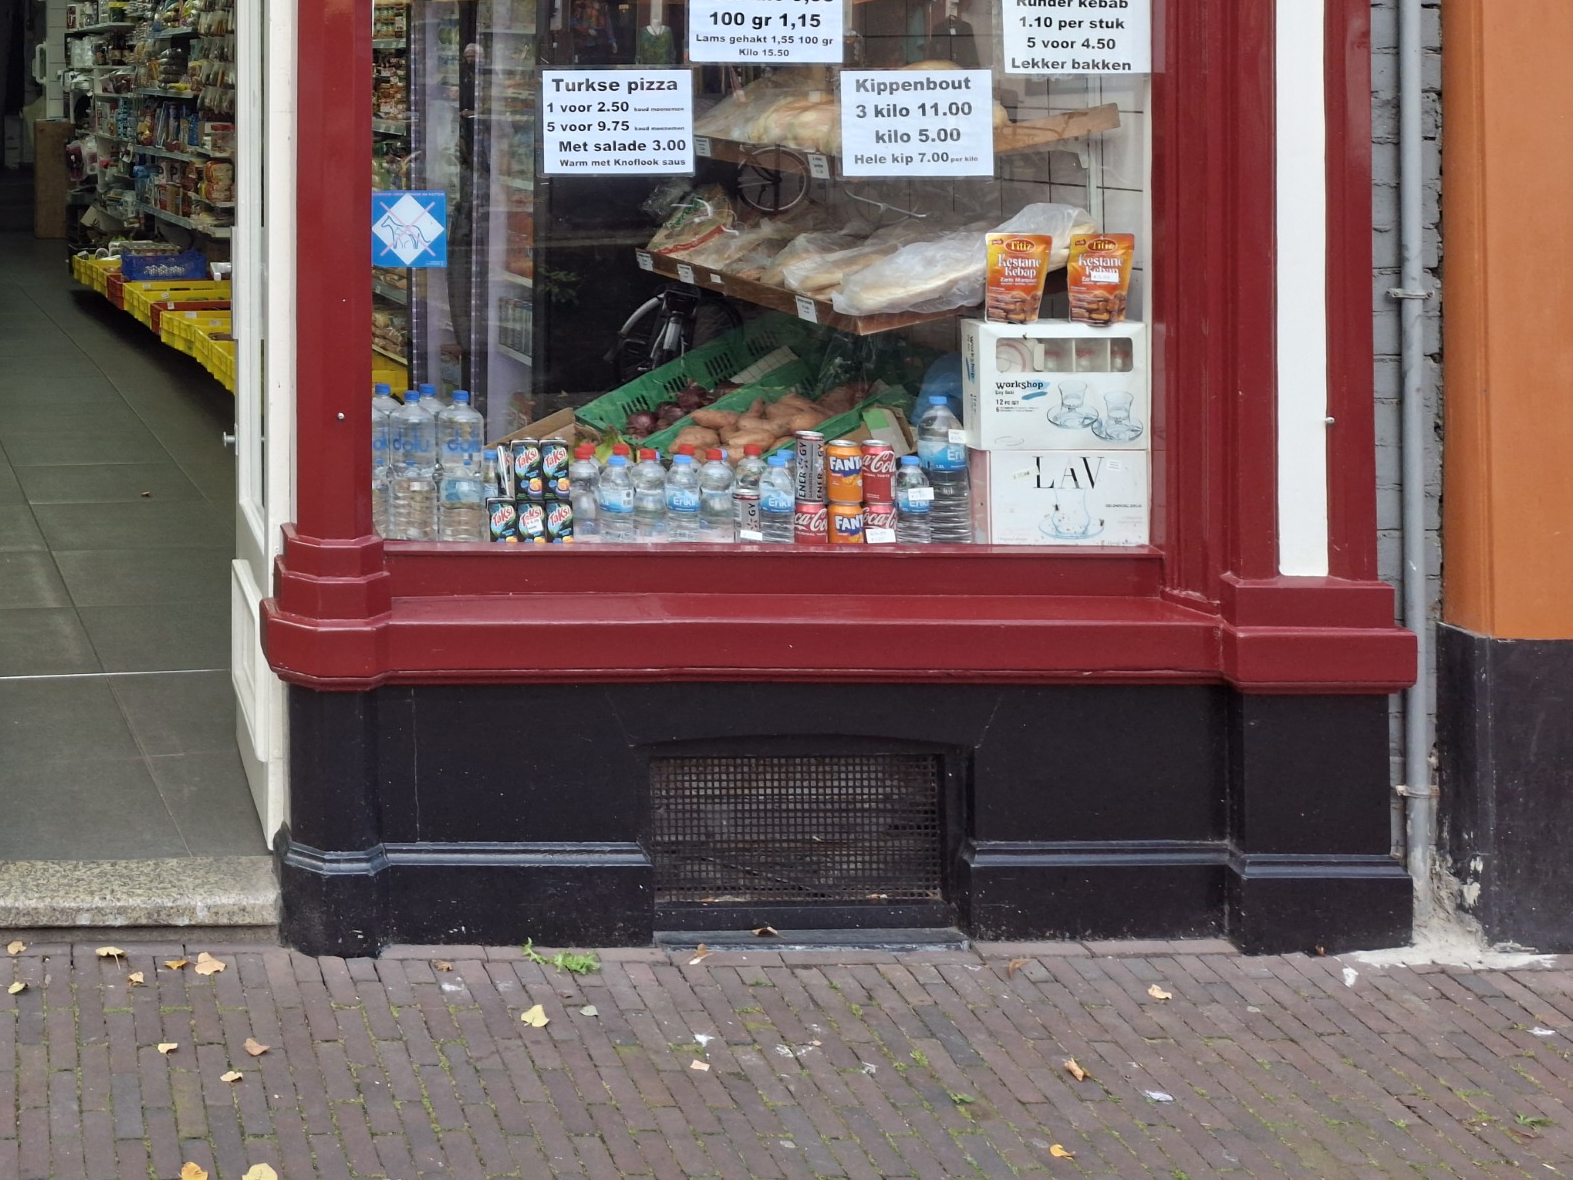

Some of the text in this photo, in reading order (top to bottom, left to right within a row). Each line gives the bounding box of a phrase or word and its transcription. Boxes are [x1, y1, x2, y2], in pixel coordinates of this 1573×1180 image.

[709, 12, 822, 30] 100 gr 1,15
[1019, 16, 1126, 32] 1.10 per stuk
[696, 34, 834, 47] Lams gehakt 1,55 100 gr
[1026, 36, 1116, 51] 5 voor 4.50
[738, 49, 790, 57] Kilo 15.50
[1011, 57, 1132, 71] Lekker bakken
[552, 77, 678, 95] Turkse pizza
[855, 76, 972, 96] Kippenbout
[547, 102, 554, 113] 1
[560, 103, 593, 113] voor
[597, 101, 630, 113] 2.50
[855, 101, 973, 119] 3 kilo 11.00
[547, 122, 556, 132] 5
[561, 122, 593, 132] voor
[597, 120, 630, 132] 9.75
[875, 128, 961, 144] kilo 5.00
[559, 139, 686, 153] Met salade 3.00
[559, 158, 588, 167] Warm
[591, 158, 611, 167] met
[614, 158, 659, 166] Knoflook
[854, 153, 887, 164] Hele
[891, 152, 914, 166] kip
[917, 151, 950, 163] 7.00
[1004, 267, 1037, 278] Kebap
[830, 456, 862, 471] FANT
[1032, 456, 1105, 490] LAV
[835, 515, 864, 530] FANT
